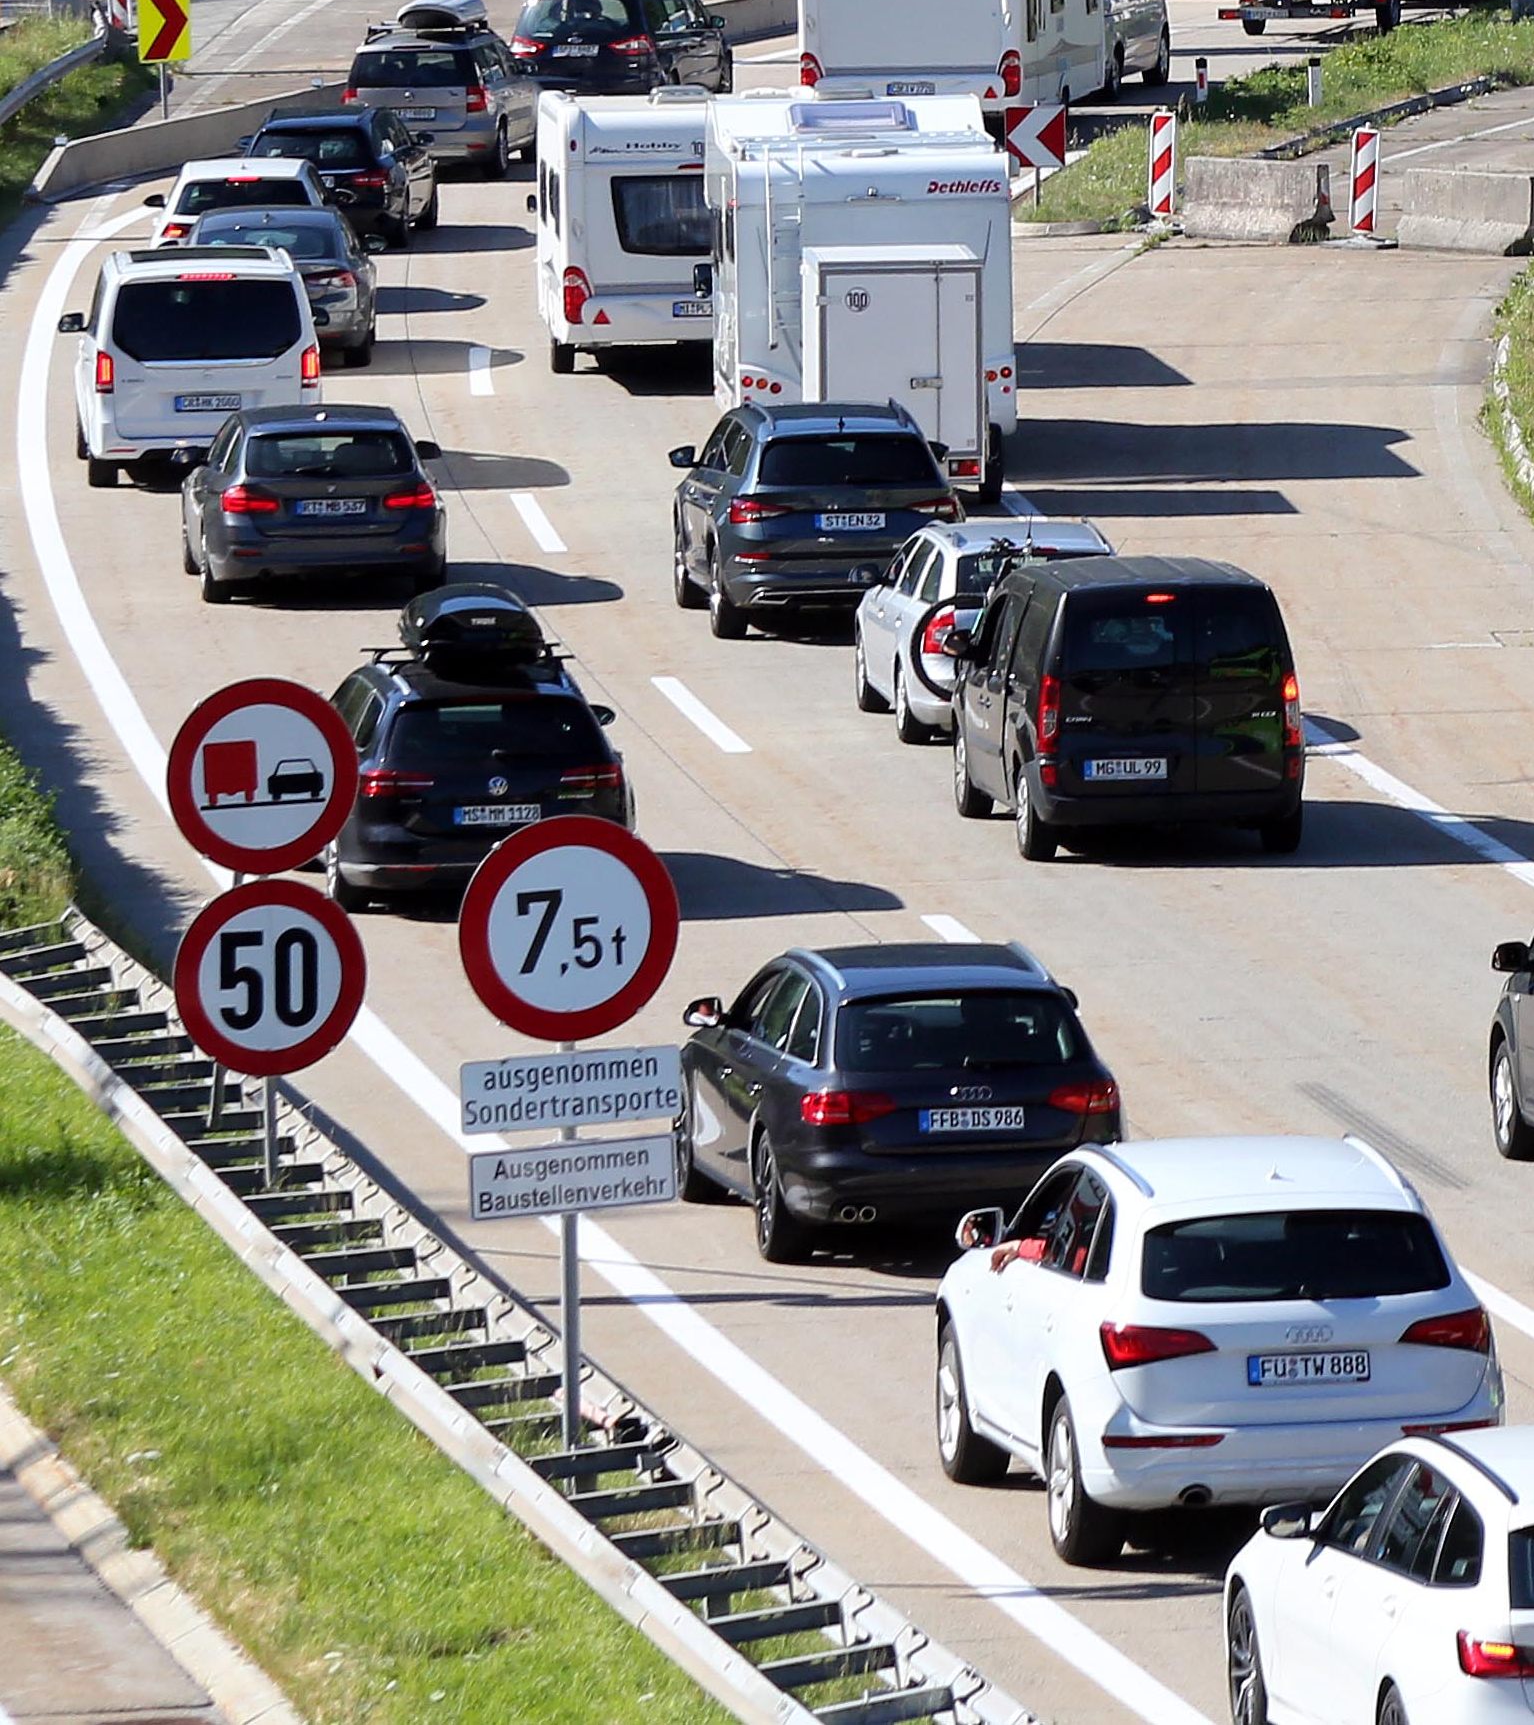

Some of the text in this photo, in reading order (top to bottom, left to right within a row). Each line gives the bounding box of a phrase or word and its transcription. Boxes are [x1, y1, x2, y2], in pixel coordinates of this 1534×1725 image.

[927, 180, 1002, 194] Dethleffs
[826, 514, 880, 527] ST EN 32
[1096, 761, 1161, 775] MG UL 99
[509, 805, 540, 820] 1128
[220, 927, 319, 1030] 50
[484, 1056, 658, 1093] ausgenommen
[465, 1086, 678, 1126] Sondertransporte
[930, 1109, 1022, 1127] FFB DS 986
[493, 1148, 650, 1182] Ausgenommen
[479, 1176, 667, 1213] Baustellenverkehr
[1300, 1356, 1325, 1376] TW
[1330, 1354, 1366, 1375] 888
